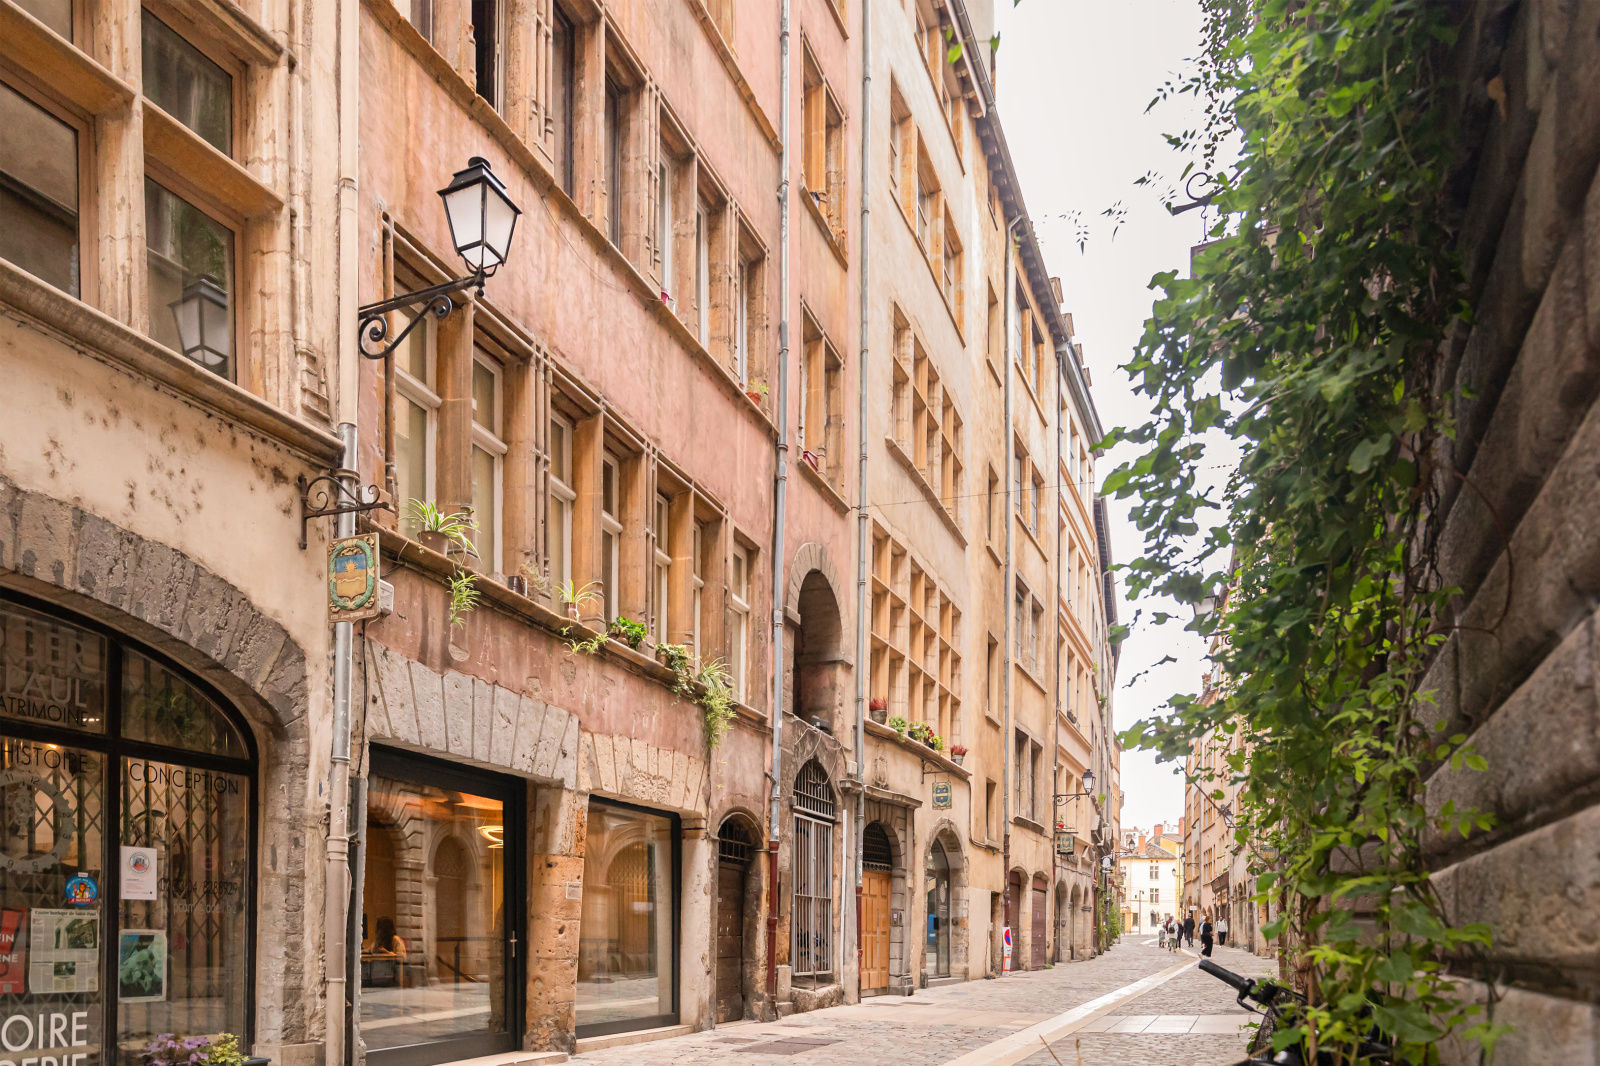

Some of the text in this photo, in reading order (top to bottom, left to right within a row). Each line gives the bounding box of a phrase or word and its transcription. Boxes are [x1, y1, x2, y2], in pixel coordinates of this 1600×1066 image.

[0, 742, 88, 776] HISTOIRE
[30, 776, 40, 786] 12
[129, 762, 239, 795] CONCEPTION
[0, 933, 15, 943] IN
[0, 954, 19, 963] NE
[1, 1011, 88, 1052] OIRE
